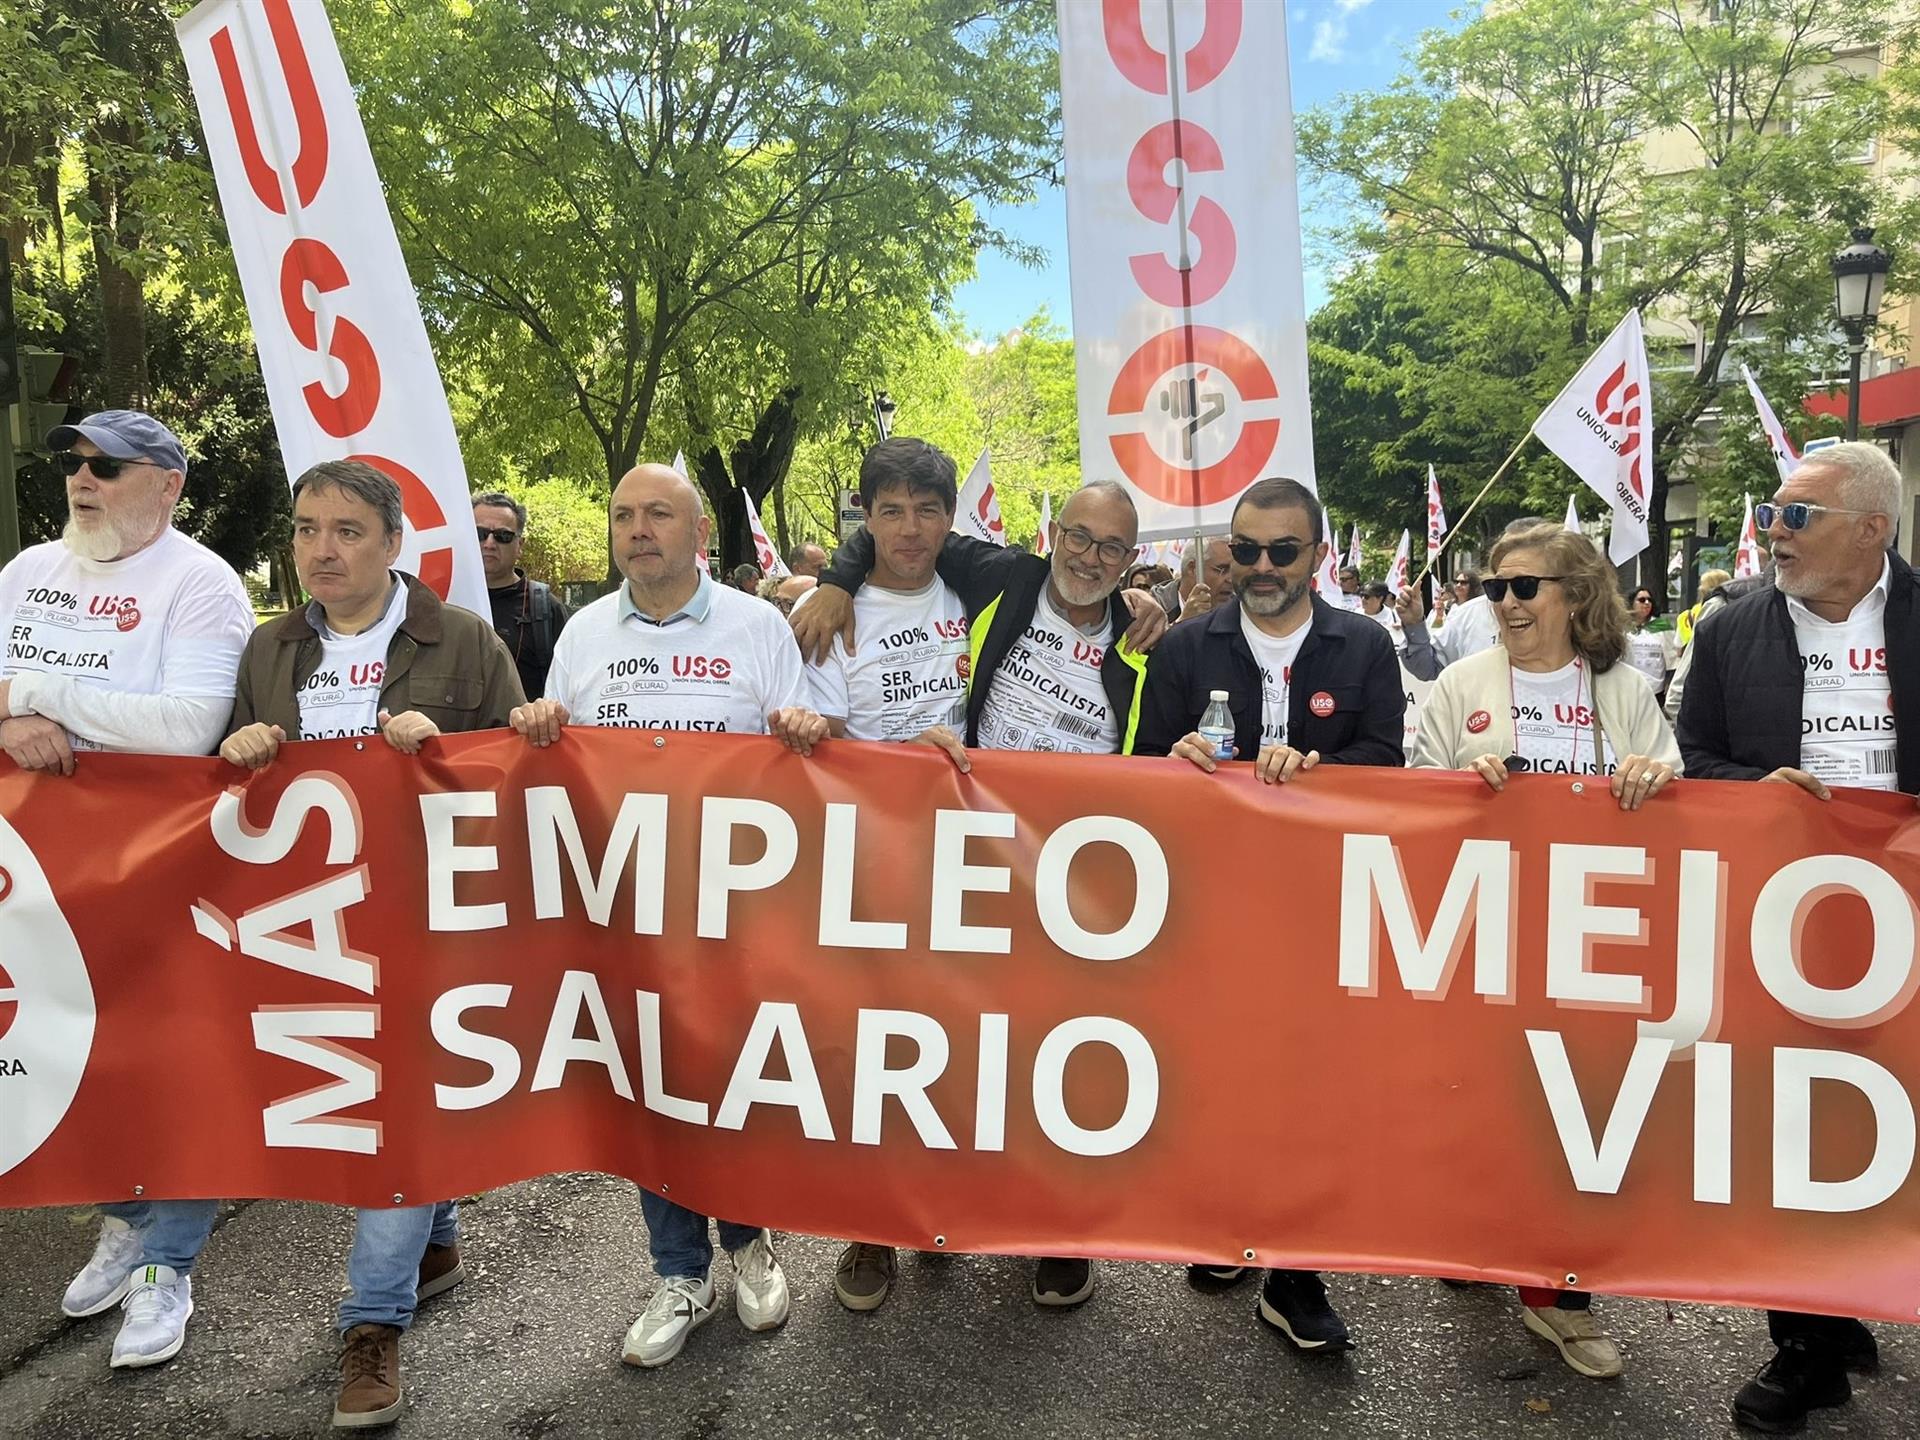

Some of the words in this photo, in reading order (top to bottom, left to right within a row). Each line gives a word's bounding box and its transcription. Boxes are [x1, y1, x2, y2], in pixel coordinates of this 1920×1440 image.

[1577, 406, 1611, 444] UNIÓN
[1616, 481, 1646, 524] OBRERA
[26, 588, 77, 610] 100%
[47, 613, 75, 624] PLURAL
[879, 627, 929, 650] 100%
[607, 657, 659, 679] 100%
[672, 655, 732, 679] USO
[605, 684, 624, 694] LIBRE
[635, 682, 665, 690] PLURAL
[882, 671, 912, 687] SER
[1804, 678, 1842, 687] PLURAL
[597, 703, 629, 720] SER
[1312, 698, 1334, 707] USO
[1468, 714, 1489, 729] USO
[1520, 726, 1553, 734] PLURAL
[418, 785, 1169, 961] EMPLEO
[1338, 832, 1920, 1062] MEJO
[189, 770, 381, 1156] MÁS
[429, 970, 1160, 1156] SALARIO
